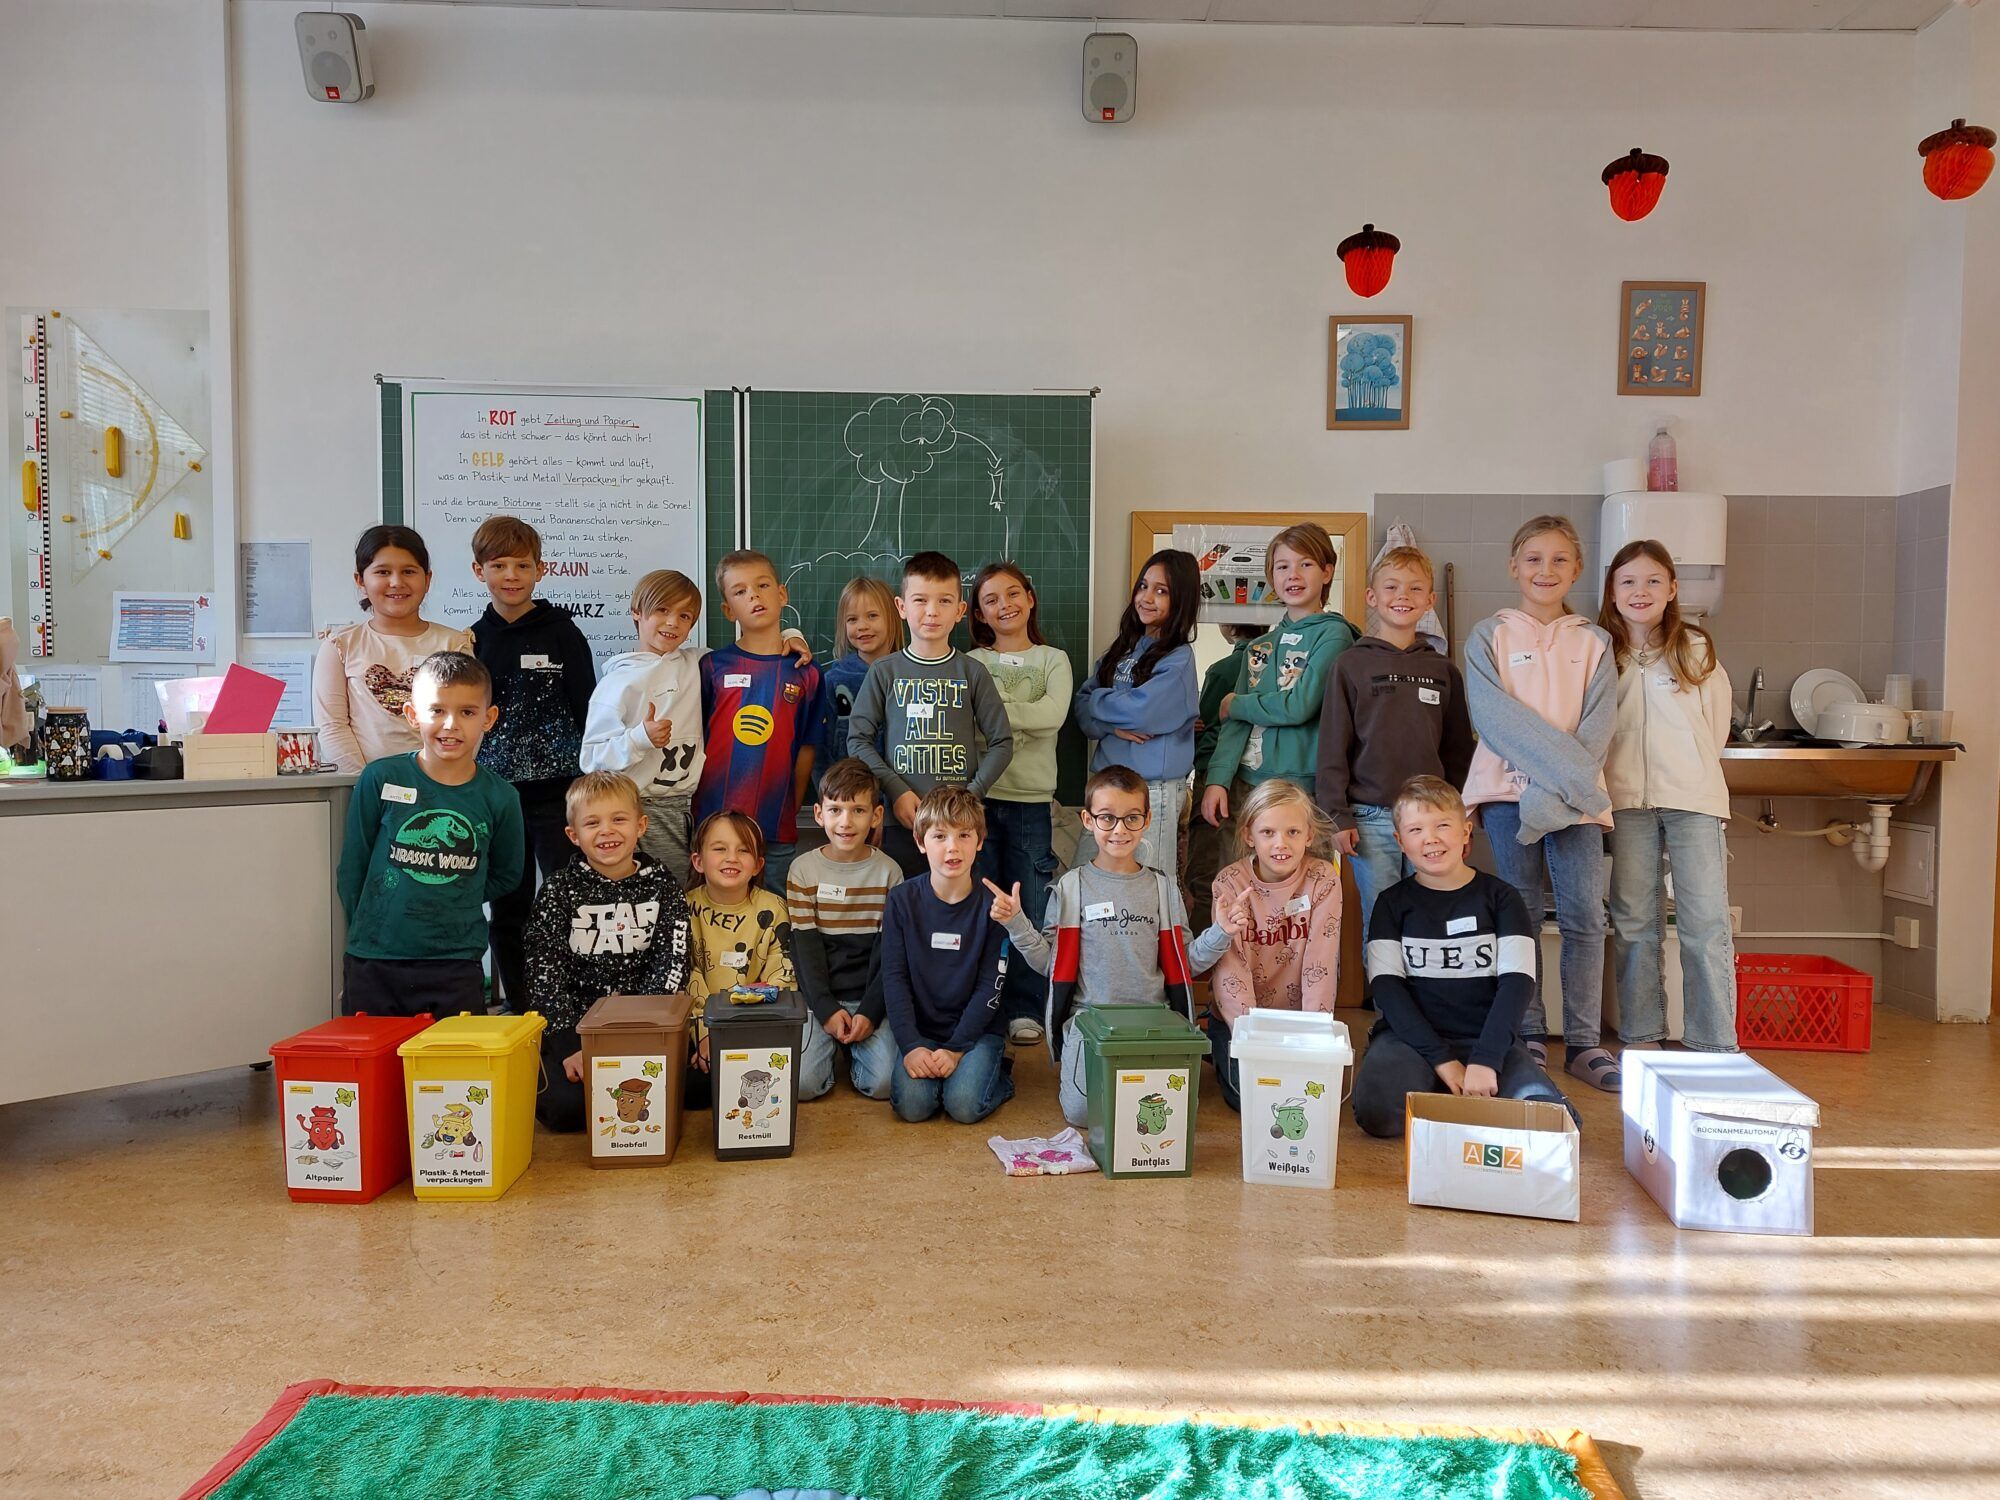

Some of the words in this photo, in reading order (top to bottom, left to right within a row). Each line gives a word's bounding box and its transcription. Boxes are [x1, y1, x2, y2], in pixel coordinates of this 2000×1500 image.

[477, 411, 486, 423] In
[489, 410, 517, 425] ROT
[521, 413, 541, 427] gebt
[546, 414, 582, 427] Zeitung
[585, 416, 600, 425] und
[603, 415, 635, 428] Papier,
[460, 430, 476, 439] das
[479, 430, 490, 439] ist
[494, 431, 517, 439] nicht
[521, 431, 552, 441] schwer
[565, 432, 580, 441] das
[583, 432, 607, 443] könnt
[611, 433, 632, 442] auch
[636, 433, 652, 443] ihr!
[459, 452, 469, 464] In
[471, 451, 505, 467] GELB
[508, 456, 538, 468] gehört
[542, 456, 563, 466] alles
[576, 456, 606, 469] kommt
[610, 457, 625, 467] und
[438, 473, 455, 481] was
[458, 473, 469, 481] an
[513, 473, 528, 482] und
[533, 472, 560, 483] Metall
[565, 473, 617, 487] Verpackung
[620, 474, 633, 484] ihr
[636, 474, 675, 487] gekauft.
[432, 497, 448, 506] und
[451, 497, 463, 507] die
[467, 496, 499, 507] braune
[503, 497, 542, 508] Biotonne
[554, 498, 579, 509] stellt
[583, 500, 595, 509] sie
[597, 499, 607, 512] ja
[610, 500, 632, 509] nicht
[636, 500, 644, 509] in
[646, 500, 659, 509] die
[662, 500, 692, 510] Sonne!
[445, 512, 467, 523] Denn
[530, 513, 546, 524] und
[550, 514, 618, 525] Bananenschalen
[583, 534, 595, 542] zu
[598, 533, 633, 543] stinken.
[551, 549, 566, 557] der
[568, 548, 597, 558] Humus
[600, 550, 628, 560] werde,
[592, 566, 604, 575] wie
[608, 564, 631, 575] Erde.
[451, 588, 473, 598] Alles
[547, 589, 572, 602] übrig
[575, 589, 602, 600] bleibt
[443, 605, 474, 616] kommt
[32, 646, 42, 656] 10
[893, 678, 968, 708] VISIT
[905, 711, 954, 741] ALL
[894, 744, 967, 775] CITIES
[389, 844, 436, 867] JURASSIC
[438, 852, 478, 870] WORLD
[571, 901, 660, 930] STAR
[1119, 908, 1154, 929] Jeans
[671, 920, 688, 956] FEEL
[738, 1132, 772, 1141] Restmüll
[1697, 1126, 1778, 1136] RÜCKNAHMEAUTOMAT
[610, 1141, 648, 1149] Bioabfall
[1464, 1144, 1522, 1168] ASZ
[1131, 1157, 1171, 1169] Buntglas
[1268, 1161, 1310, 1174] Weißglas
[305, 1173, 345, 1183] Altpapier
[419, 1169, 451, 1177] Plastik-
[460, 1169, 490, 1177] Metall-
[426, 1176, 484, 1185] verpackungen
